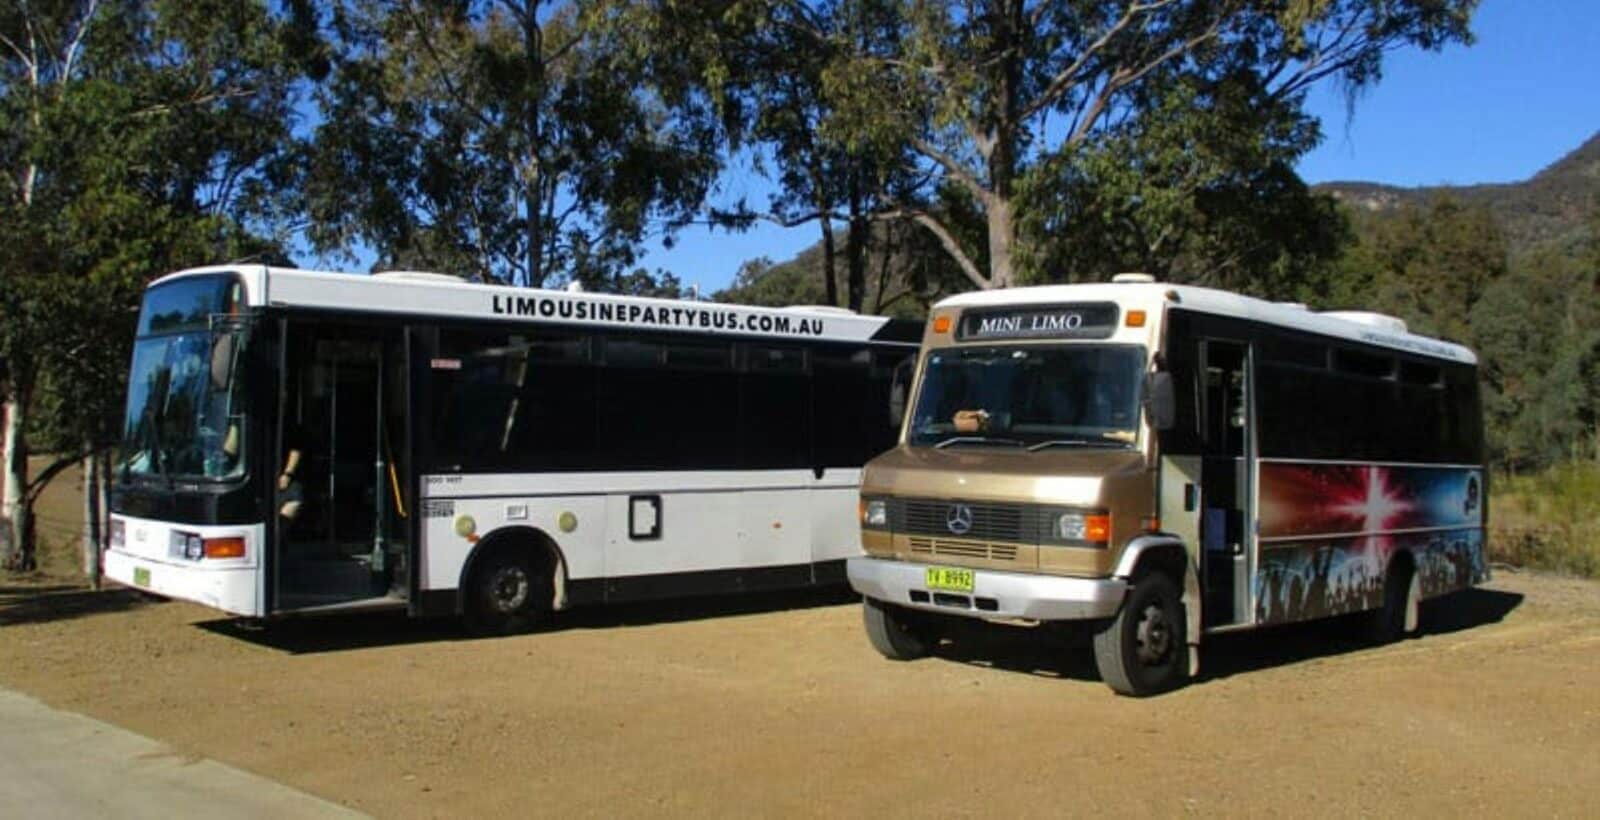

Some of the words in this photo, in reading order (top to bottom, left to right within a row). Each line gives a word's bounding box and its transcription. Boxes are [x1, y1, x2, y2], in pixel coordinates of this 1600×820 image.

[492, 294, 824, 335] LIMOUSINEPARTYBUS.COM.AU
[980, 316, 1022, 332] MINI
[1031, 314, 1082, 331] LIMO
